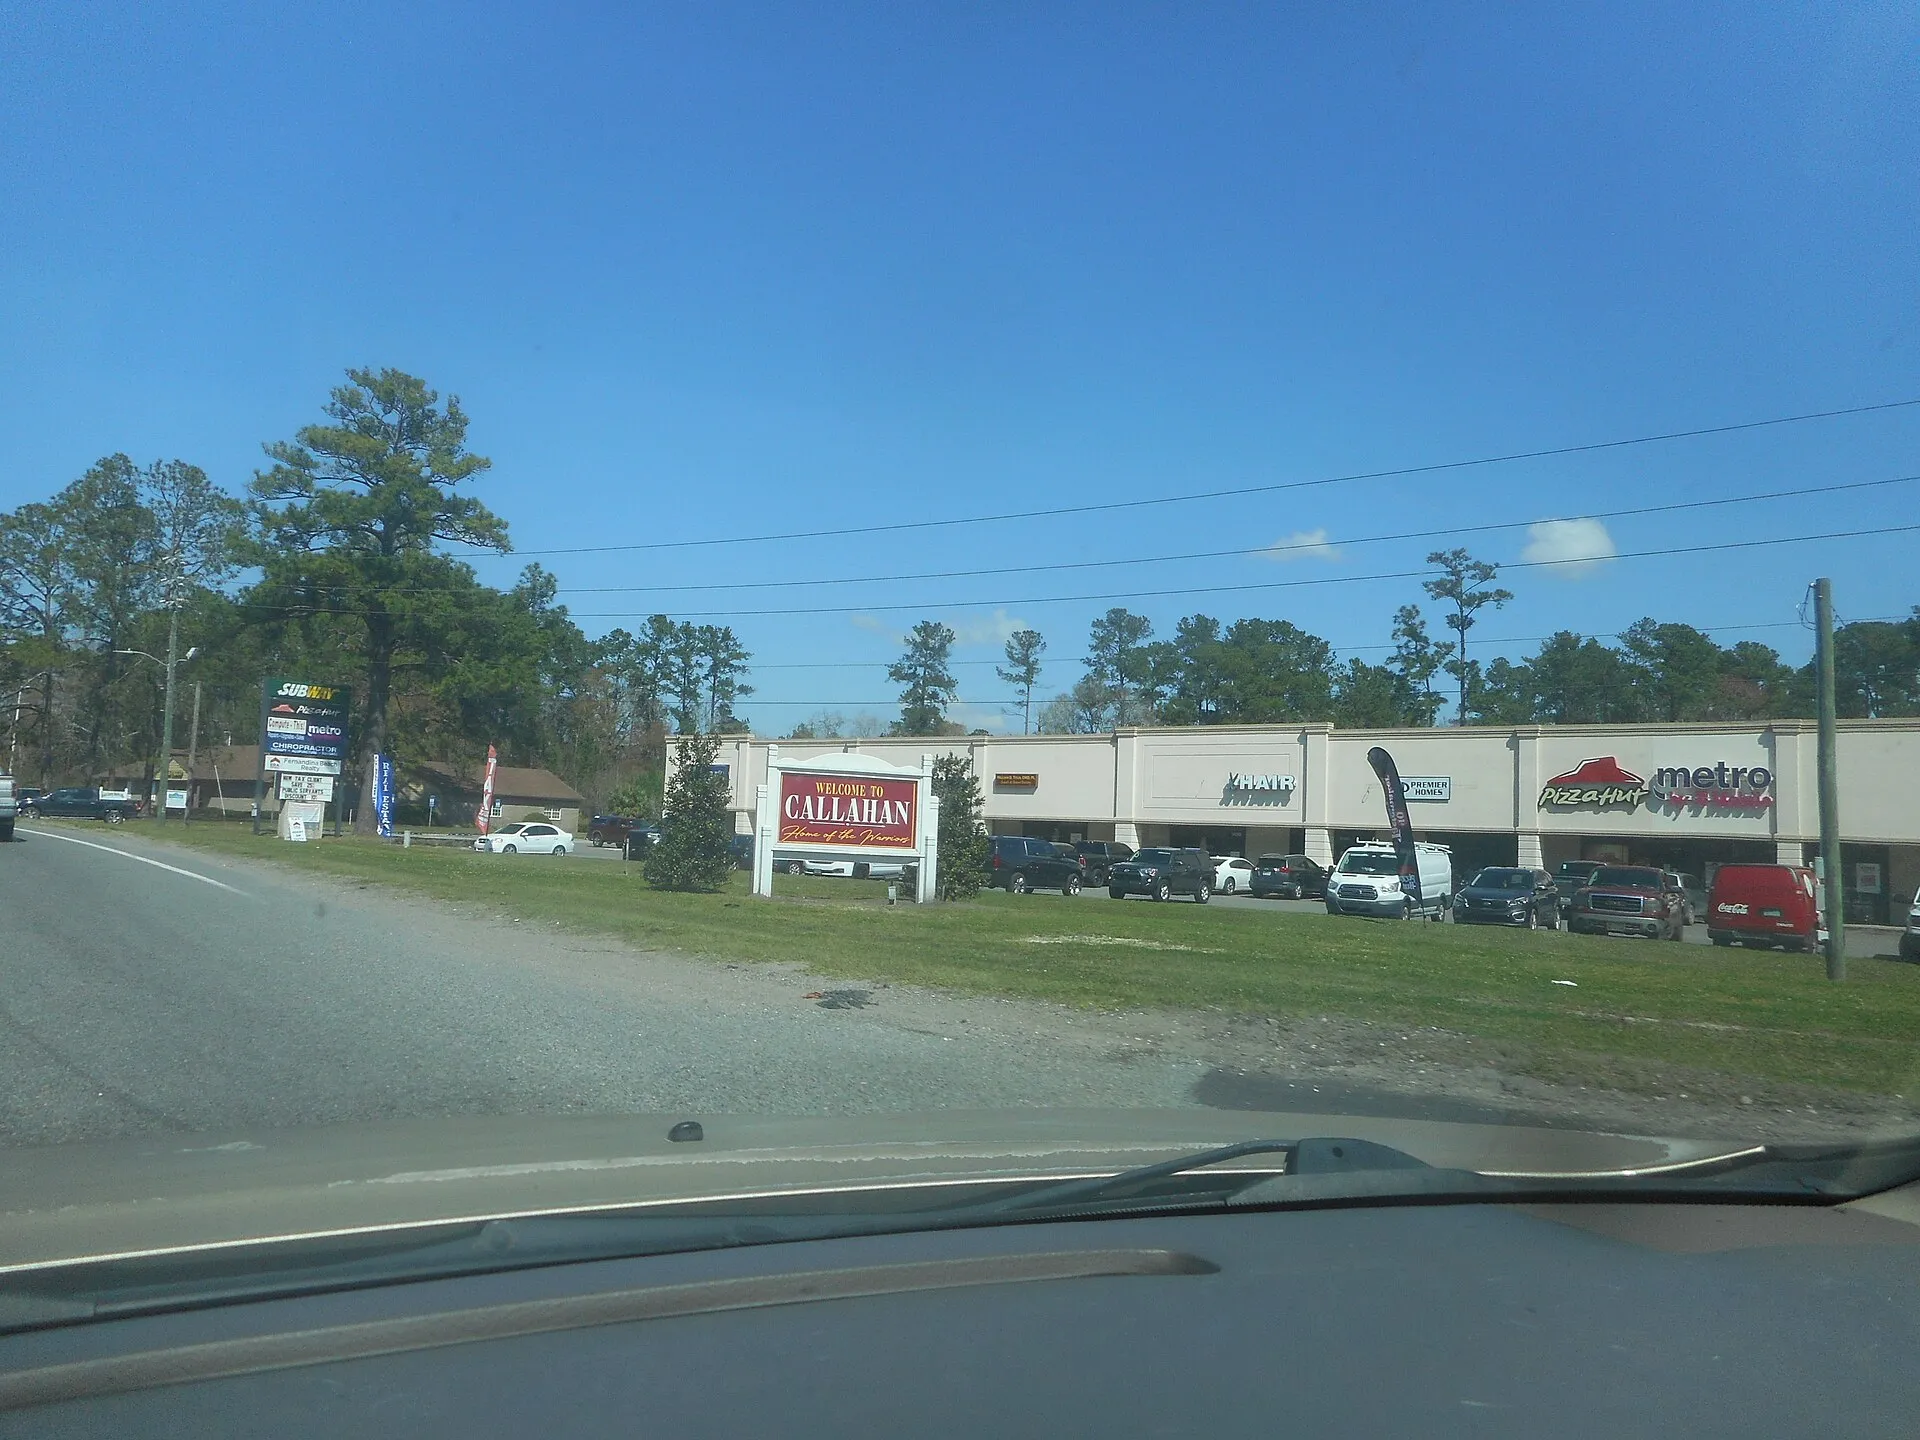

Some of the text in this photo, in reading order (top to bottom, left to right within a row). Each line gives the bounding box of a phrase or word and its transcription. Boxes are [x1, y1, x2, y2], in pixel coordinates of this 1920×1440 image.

[277, 682, 340, 700] SUBWAY
[296, 705, 321, 715] Pizza
[308, 724, 342, 736] metro
[272, 742, 337, 753] CHIROPRACTOR
[300, 764, 320, 772] Realty
[1656, 760, 1773, 789] metro
[816, 782, 884, 798] WELCOME TO
[1239, 773, 1297, 791] HAIR
[1410, 780, 1448, 790] PREMIER
[1415, 788, 1444, 796] HOMES
[1537, 786, 1599, 807] Pizza
[1598, 785, 1650, 807] Hut
[785, 794, 911, 825] CALLAHAN
[781, 825, 911, 846] Home of the Warriors
